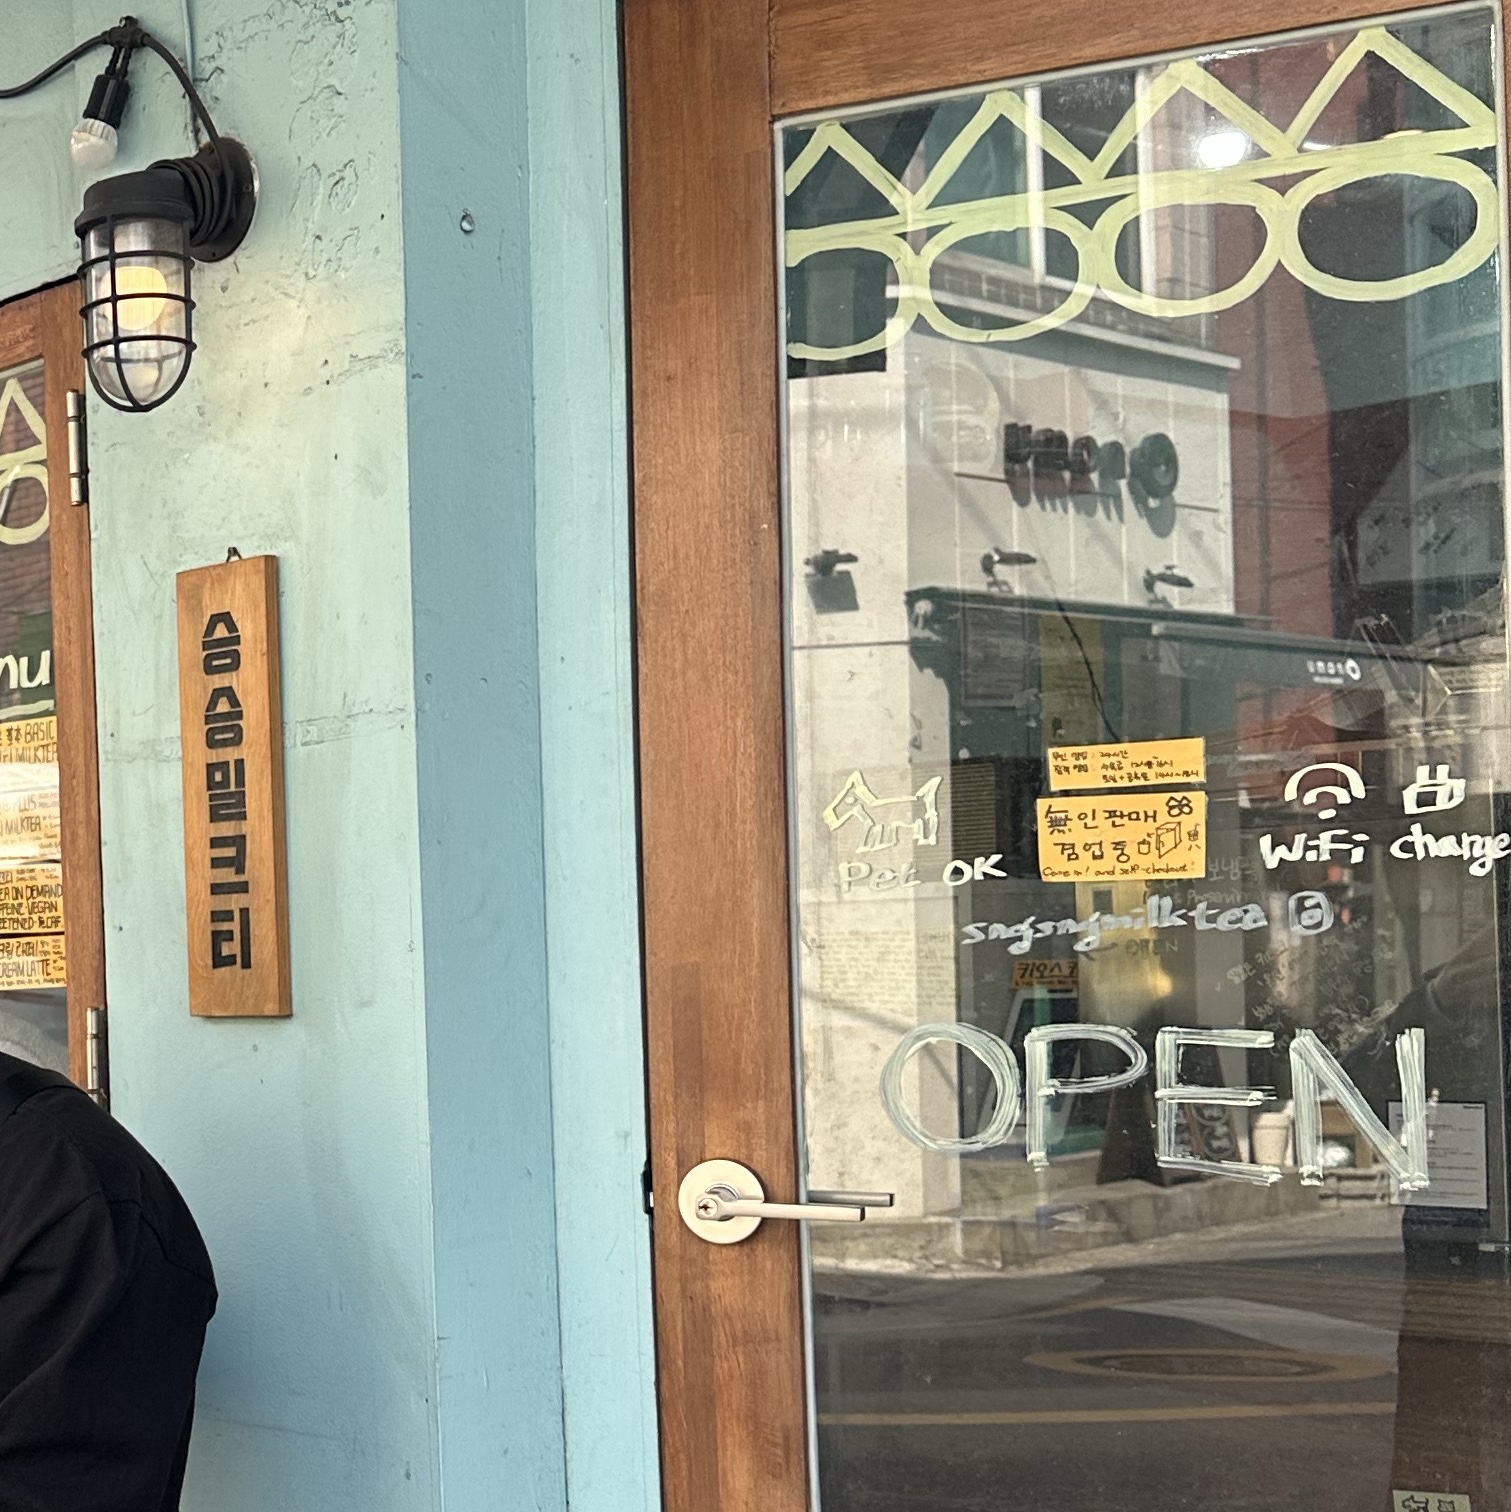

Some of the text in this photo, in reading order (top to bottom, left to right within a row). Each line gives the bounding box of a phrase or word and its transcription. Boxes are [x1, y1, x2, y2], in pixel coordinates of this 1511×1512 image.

[24, 720, 56, 744] BASIC
[1259, 822, 1511, 877] WiFi charge
[839, 853, 1007, 893] Pet OK
[1094, 864, 1116, 876] and
[880, 1020, 1430, 1191] OPEN
